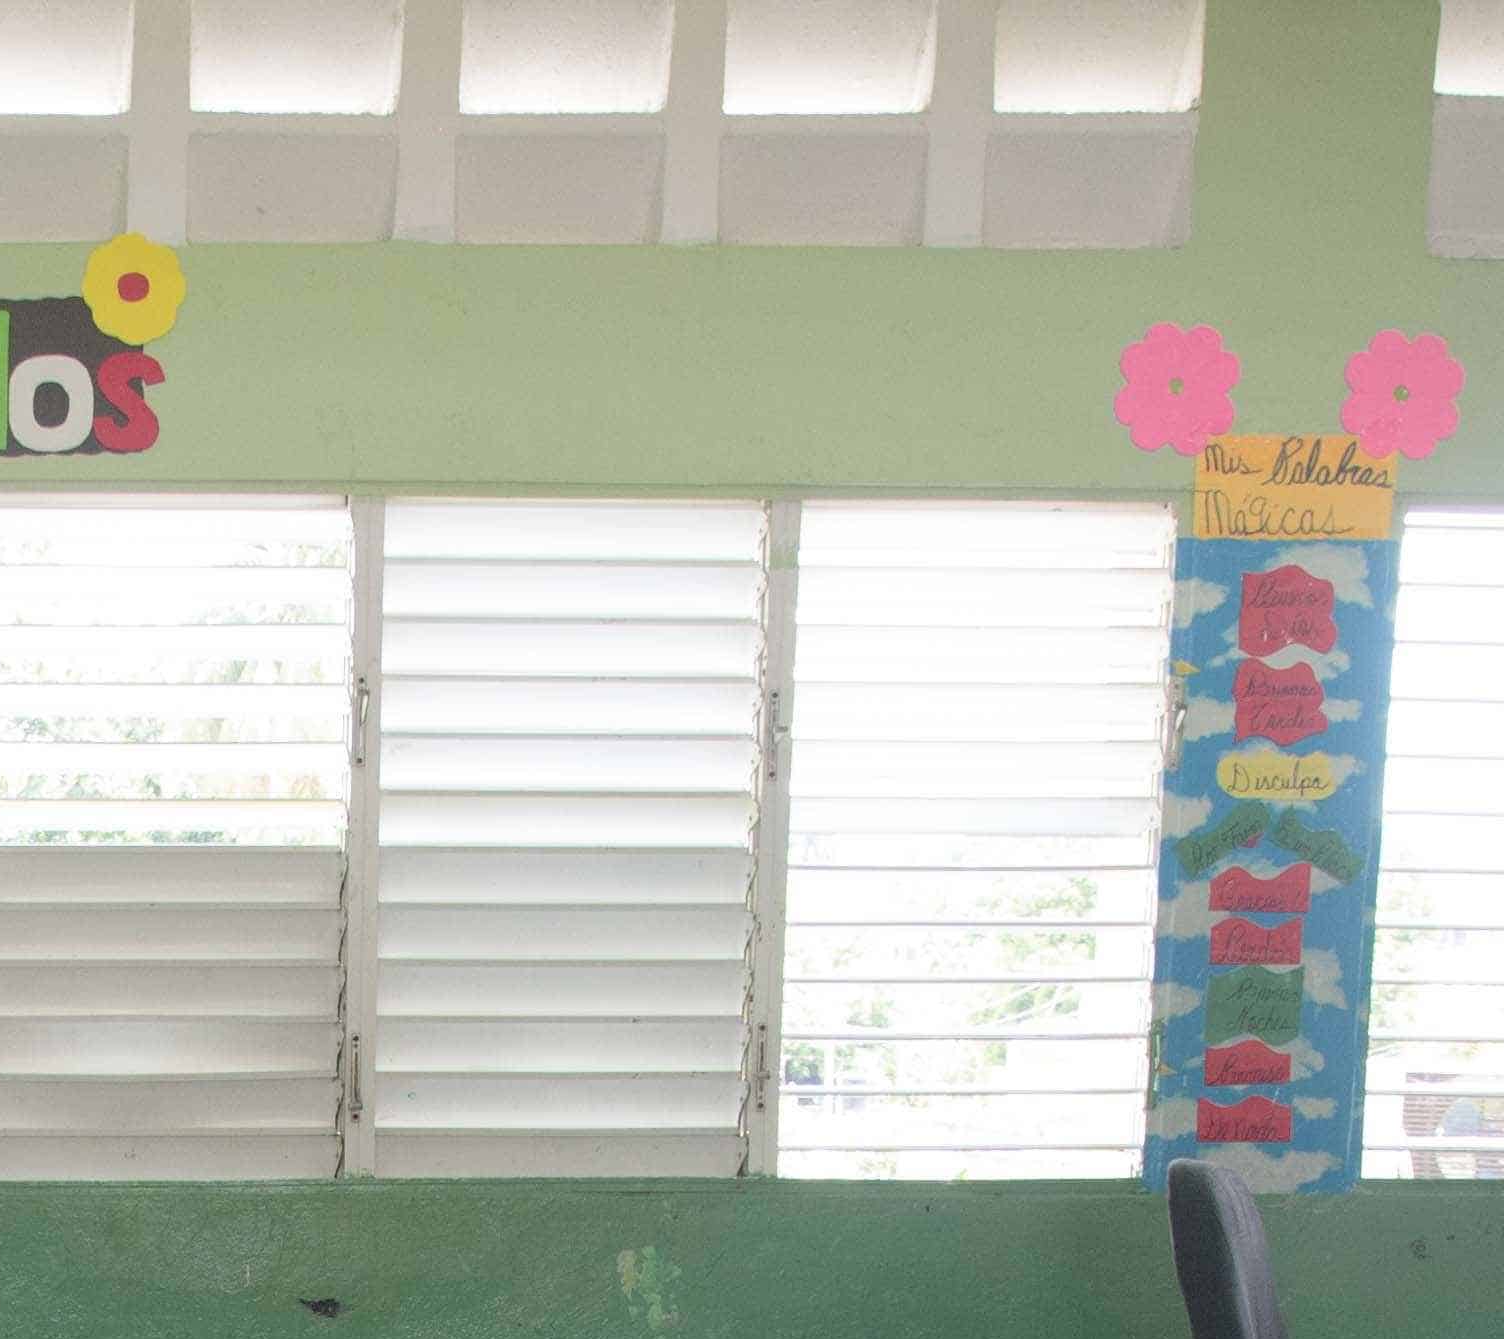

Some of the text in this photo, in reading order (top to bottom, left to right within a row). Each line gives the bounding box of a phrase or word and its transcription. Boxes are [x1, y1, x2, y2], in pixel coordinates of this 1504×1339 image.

[1204, 435, 1394, 488] Mis Palabras
[1228, 762, 1329, 796] Disculpa
